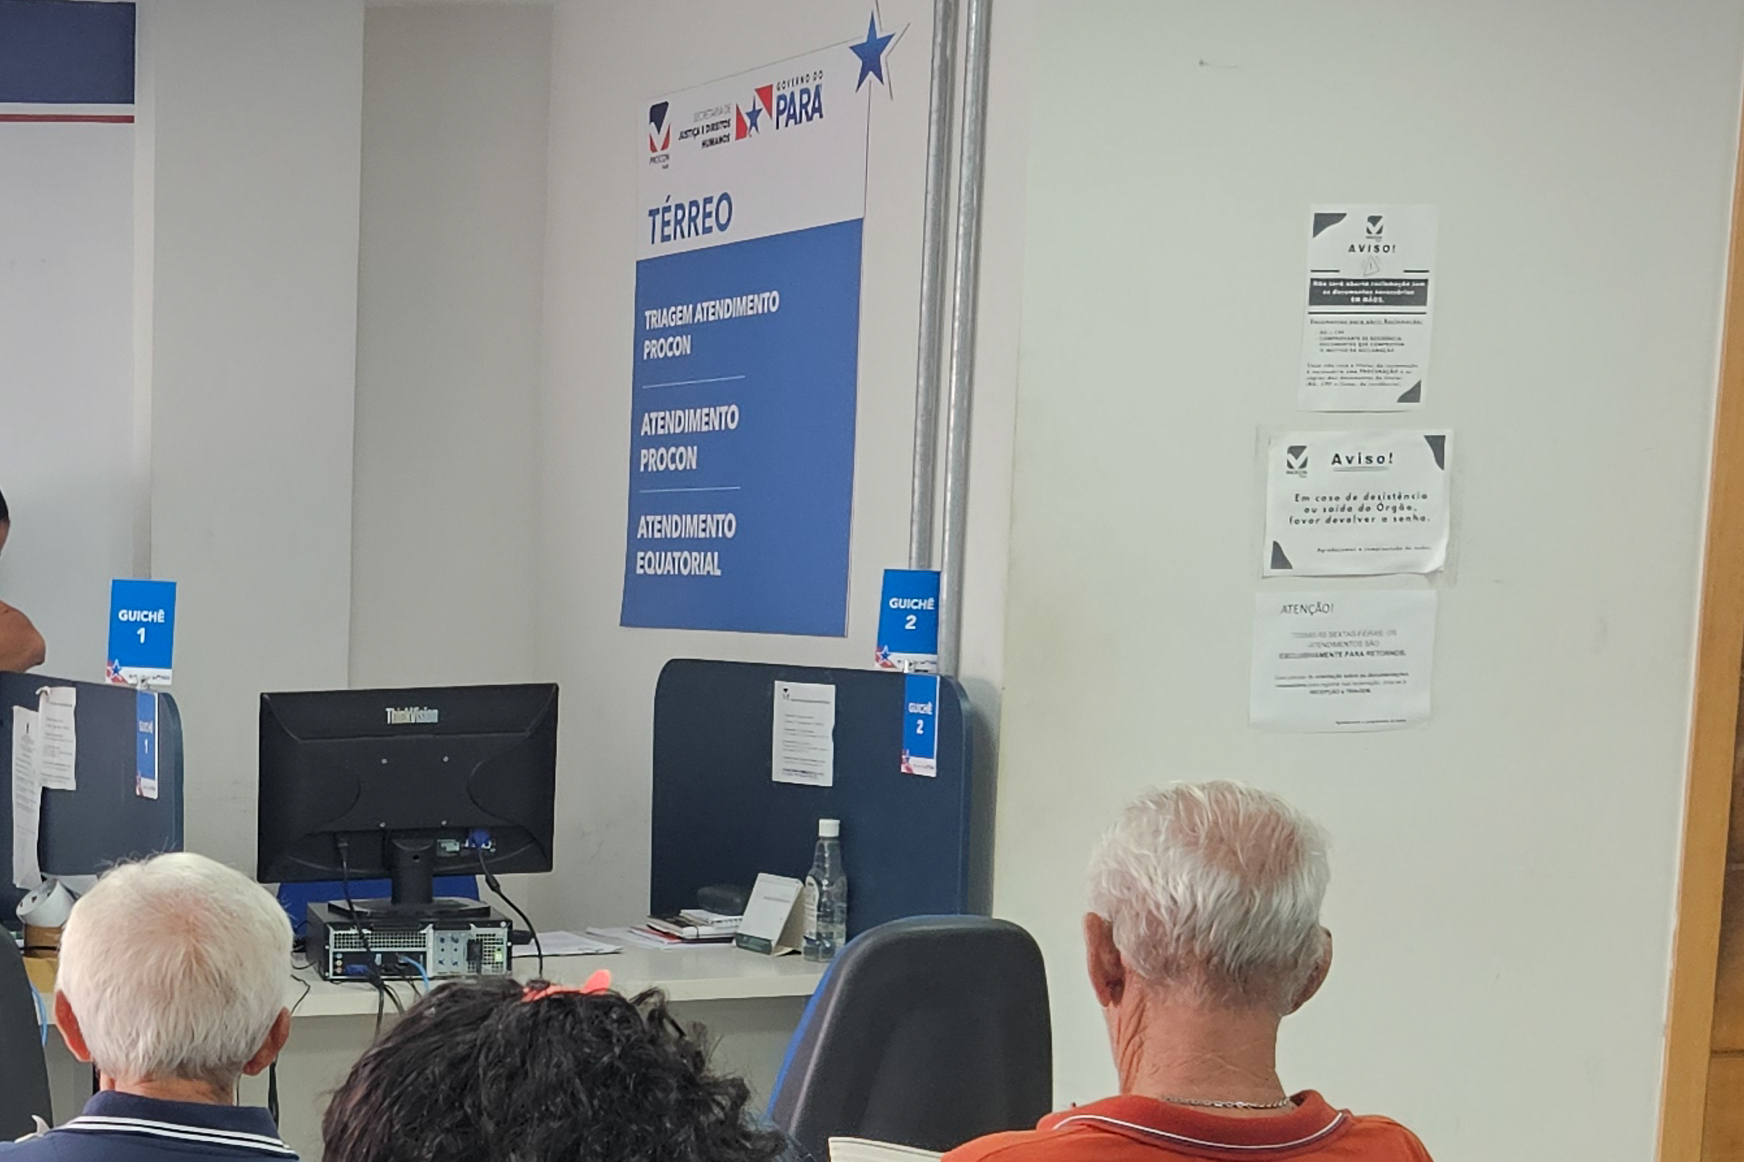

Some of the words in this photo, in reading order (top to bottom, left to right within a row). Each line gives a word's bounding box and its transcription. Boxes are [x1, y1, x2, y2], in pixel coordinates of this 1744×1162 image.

[775, 83, 824, 130] PARÁ
[648, 192, 733, 245] TÉRREO
[645, 304, 693, 330] TRIAGEM
[694, 290, 780, 324] ATENDIMENTO
[643, 335, 691, 360] PROCON
[641, 404, 740, 436] ATENDIMENTO
[640, 446, 697, 472] PROCON
[1331, 452, 1394, 466] Aviso!
[637, 513, 736, 538] ATENDIMENTO
[636, 551, 721, 576] EQUATORIAL
[889, 597, 935, 610] GUICHÊ
[1280, 601, 1334, 616] ATENÇÃO!
[118, 609, 165, 623] GUICHÊ
[905, 615, 917, 630] 2
[137, 627, 146, 644] 1
[386, 706, 439, 724] ThinkVision
[916, 719, 925, 735] 2
